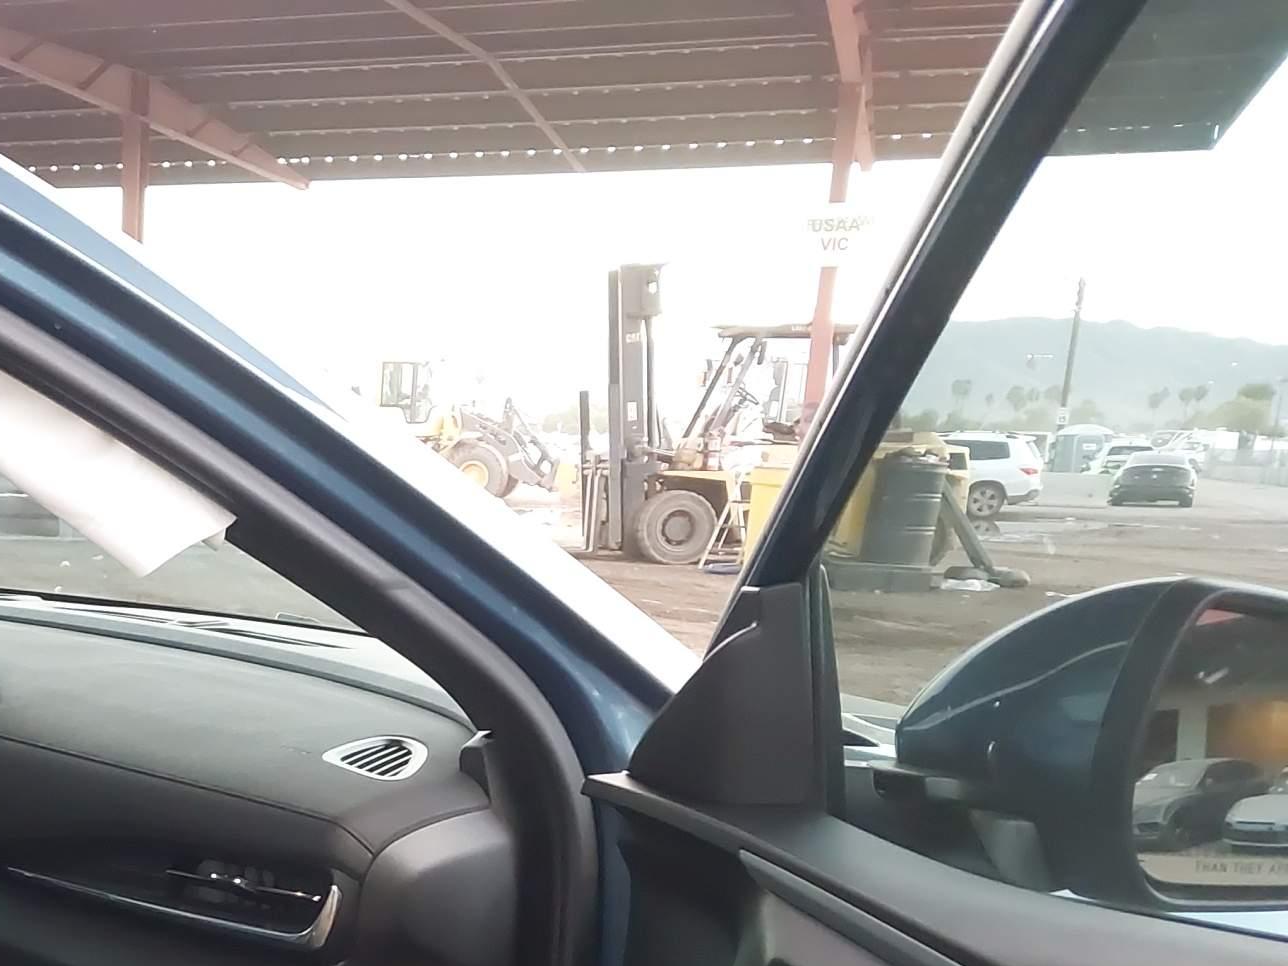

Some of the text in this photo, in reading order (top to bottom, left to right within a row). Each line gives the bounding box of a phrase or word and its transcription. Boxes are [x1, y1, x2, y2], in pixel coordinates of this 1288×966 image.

[811, 218, 861, 232] USAA
[820, 237, 849, 251] VIC
[1195, 860, 1227, 873] THAN
[1233, 861, 1264, 874] THEY
